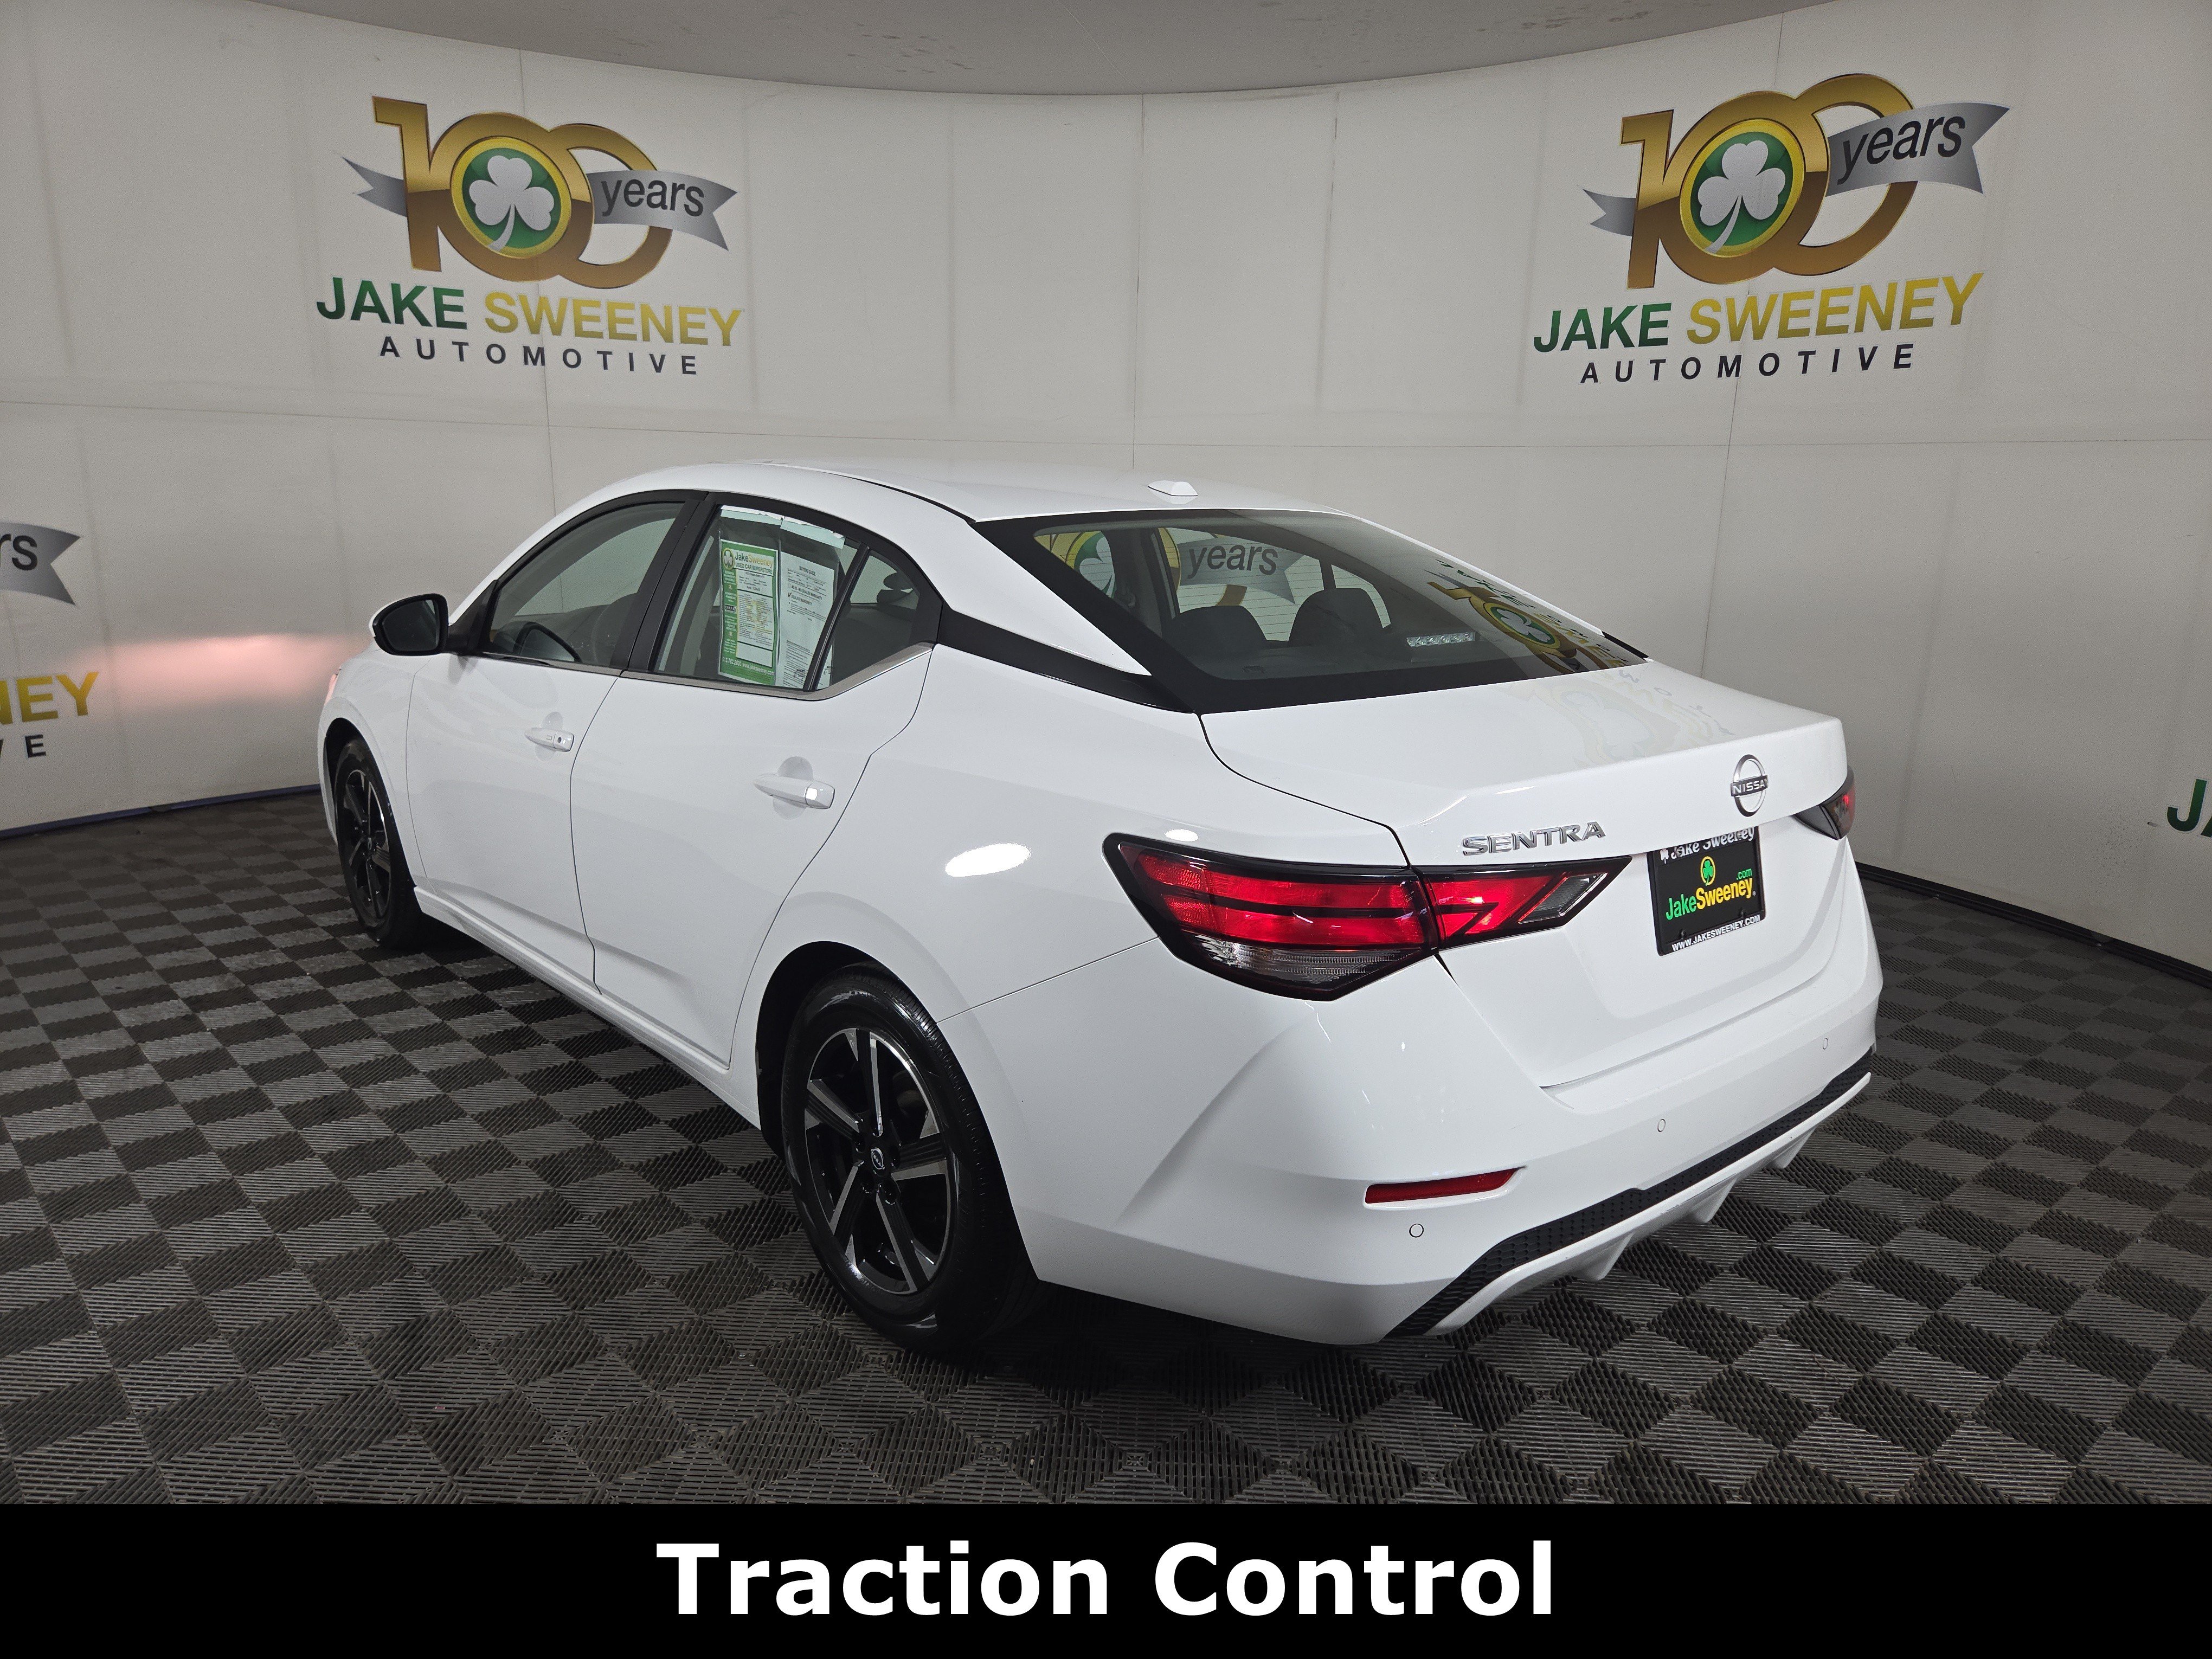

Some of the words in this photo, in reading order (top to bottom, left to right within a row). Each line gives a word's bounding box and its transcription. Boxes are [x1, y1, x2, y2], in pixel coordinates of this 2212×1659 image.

[1837, 115, 1966, 185] years
[601, 178, 705, 217] years
[316, 277, 467, 330] JAKE
[484, 293, 742, 347] SWEENEY
[1533, 303, 1672, 352] JAKE
[1687, 273, 1984, 344] SWEENEY
[380, 336, 697, 375] AUTOMOTIVE
[1580, 343, 1915, 383] AUTOMOTIVE
[1187, 544, 1278, 579] years
[1462, 821, 1606, 856] SENTRA
[1736, 868, 1752, 880] .com
[1666, 878, 1753, 920] JakeSweeney
[1671, 914, 1760, 951] WWW.JAKESWEENEY.COM
